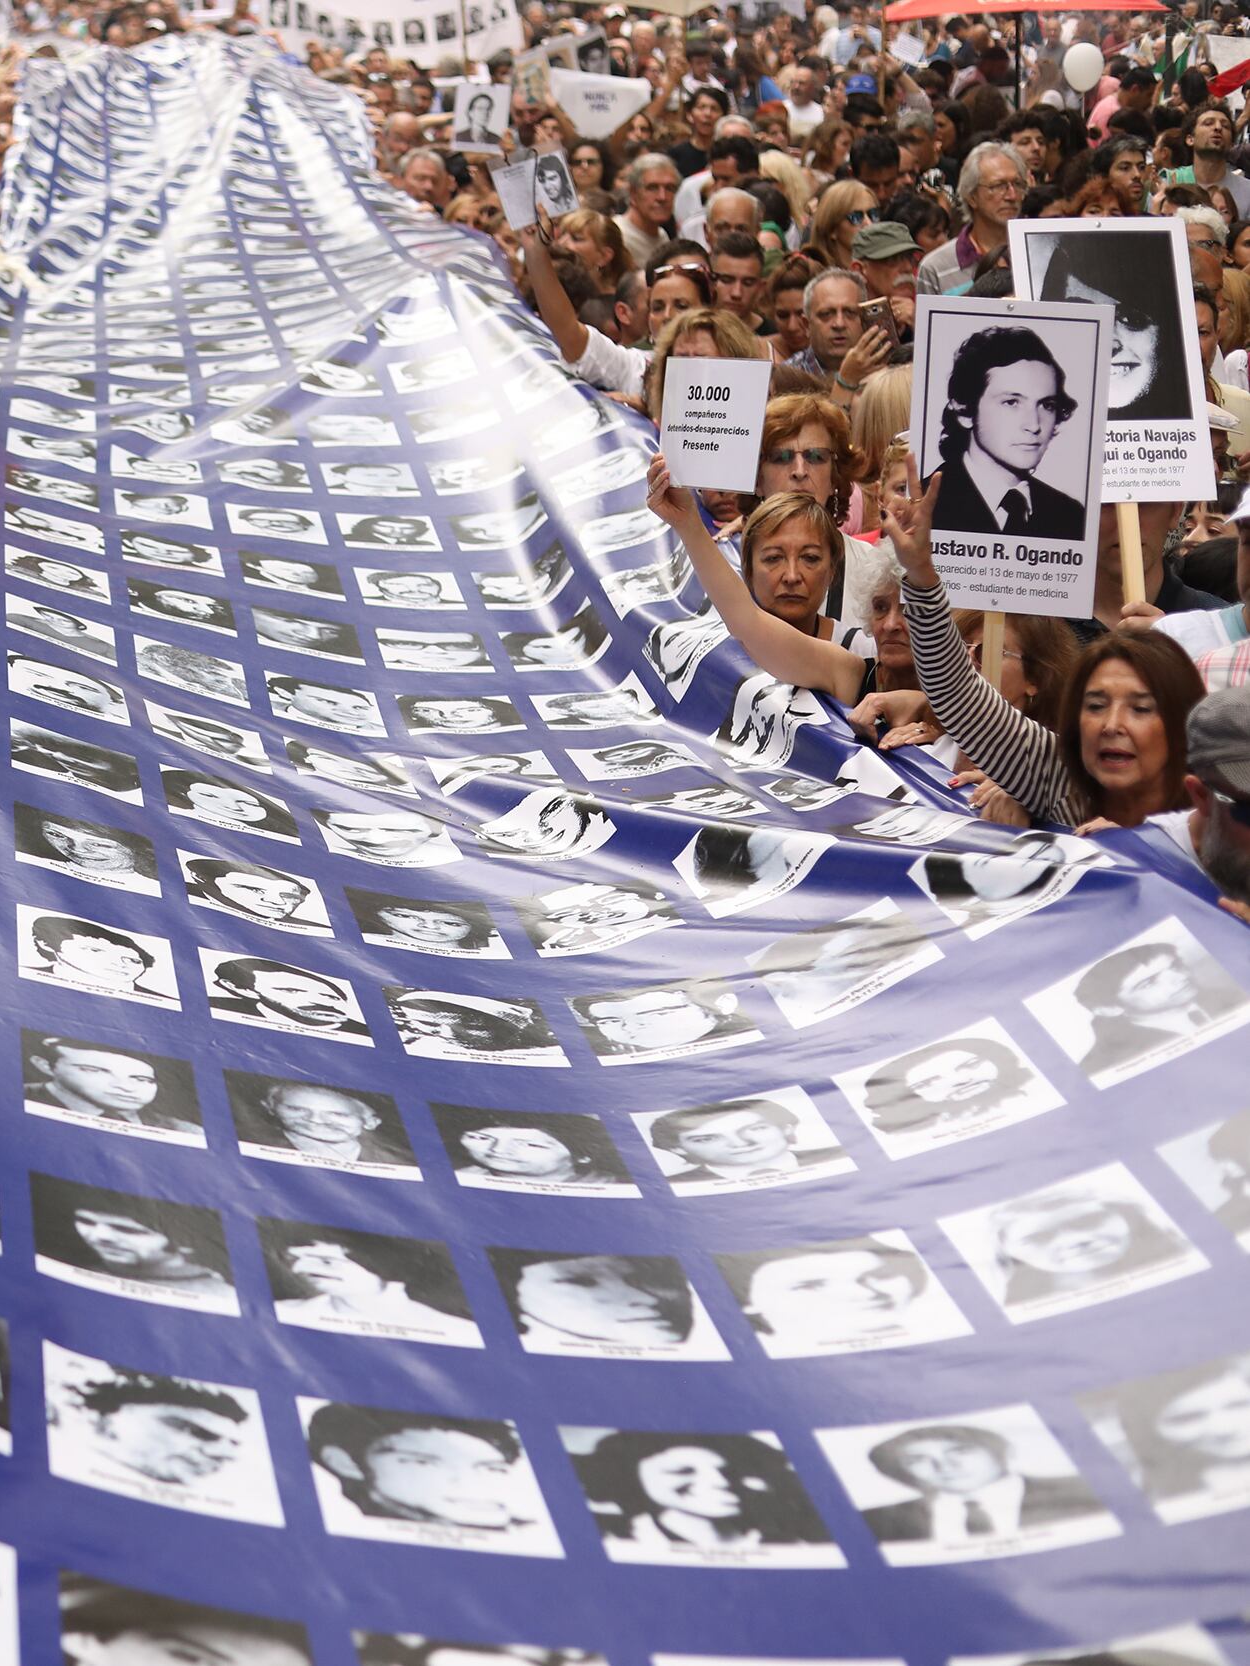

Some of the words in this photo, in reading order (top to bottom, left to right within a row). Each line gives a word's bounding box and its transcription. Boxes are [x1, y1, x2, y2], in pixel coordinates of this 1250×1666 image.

[687, 385, 731, 402] 30.000
[685, 409, 727, 420] compañeros
[667, 423, 750, 436] detenidos-desaparecidos
[1105, 429, 1141, 443] ctoria
[1144, 429, 1197, 444] Navajas
[682, 439, 720, 452] Presente
[1123, 451, 1135, 460] de
[1138, 447, 1188, 463] Ogando
[1112, 467, 1118, 475] el
[1119, 467, 1128, 475] 13
[1129, 467, 1138, 475] de
[1139, 467, 1157, 477] mayo
[1158, 466, 1167, 474] de
[1168, 465, 1185, 475] 1977
[1106, 478, 1140, 488] estudiante
[1141, 478, 1150, 487] de
[1152, 478, 1181, 487] medicina
[931, 540, 987, 559] ustavo
[993, 543, 1009, 560] R.
[1015, 544, 1083, 567] Ogando
[979, 566, 987, 576] el
[990, 567, 1000, 577] 13
[1002, 568, 1014, 579] de
[1016, 571, 1040, 582] mayo
[1042, 571, 1054, 582] de
[1056, 572, 1078, 584] 1977
[969, 583, 1014, 595] estudiante
[1016, 586, 1027, 597] de
[1029, 588, 1069, 600] medicina
